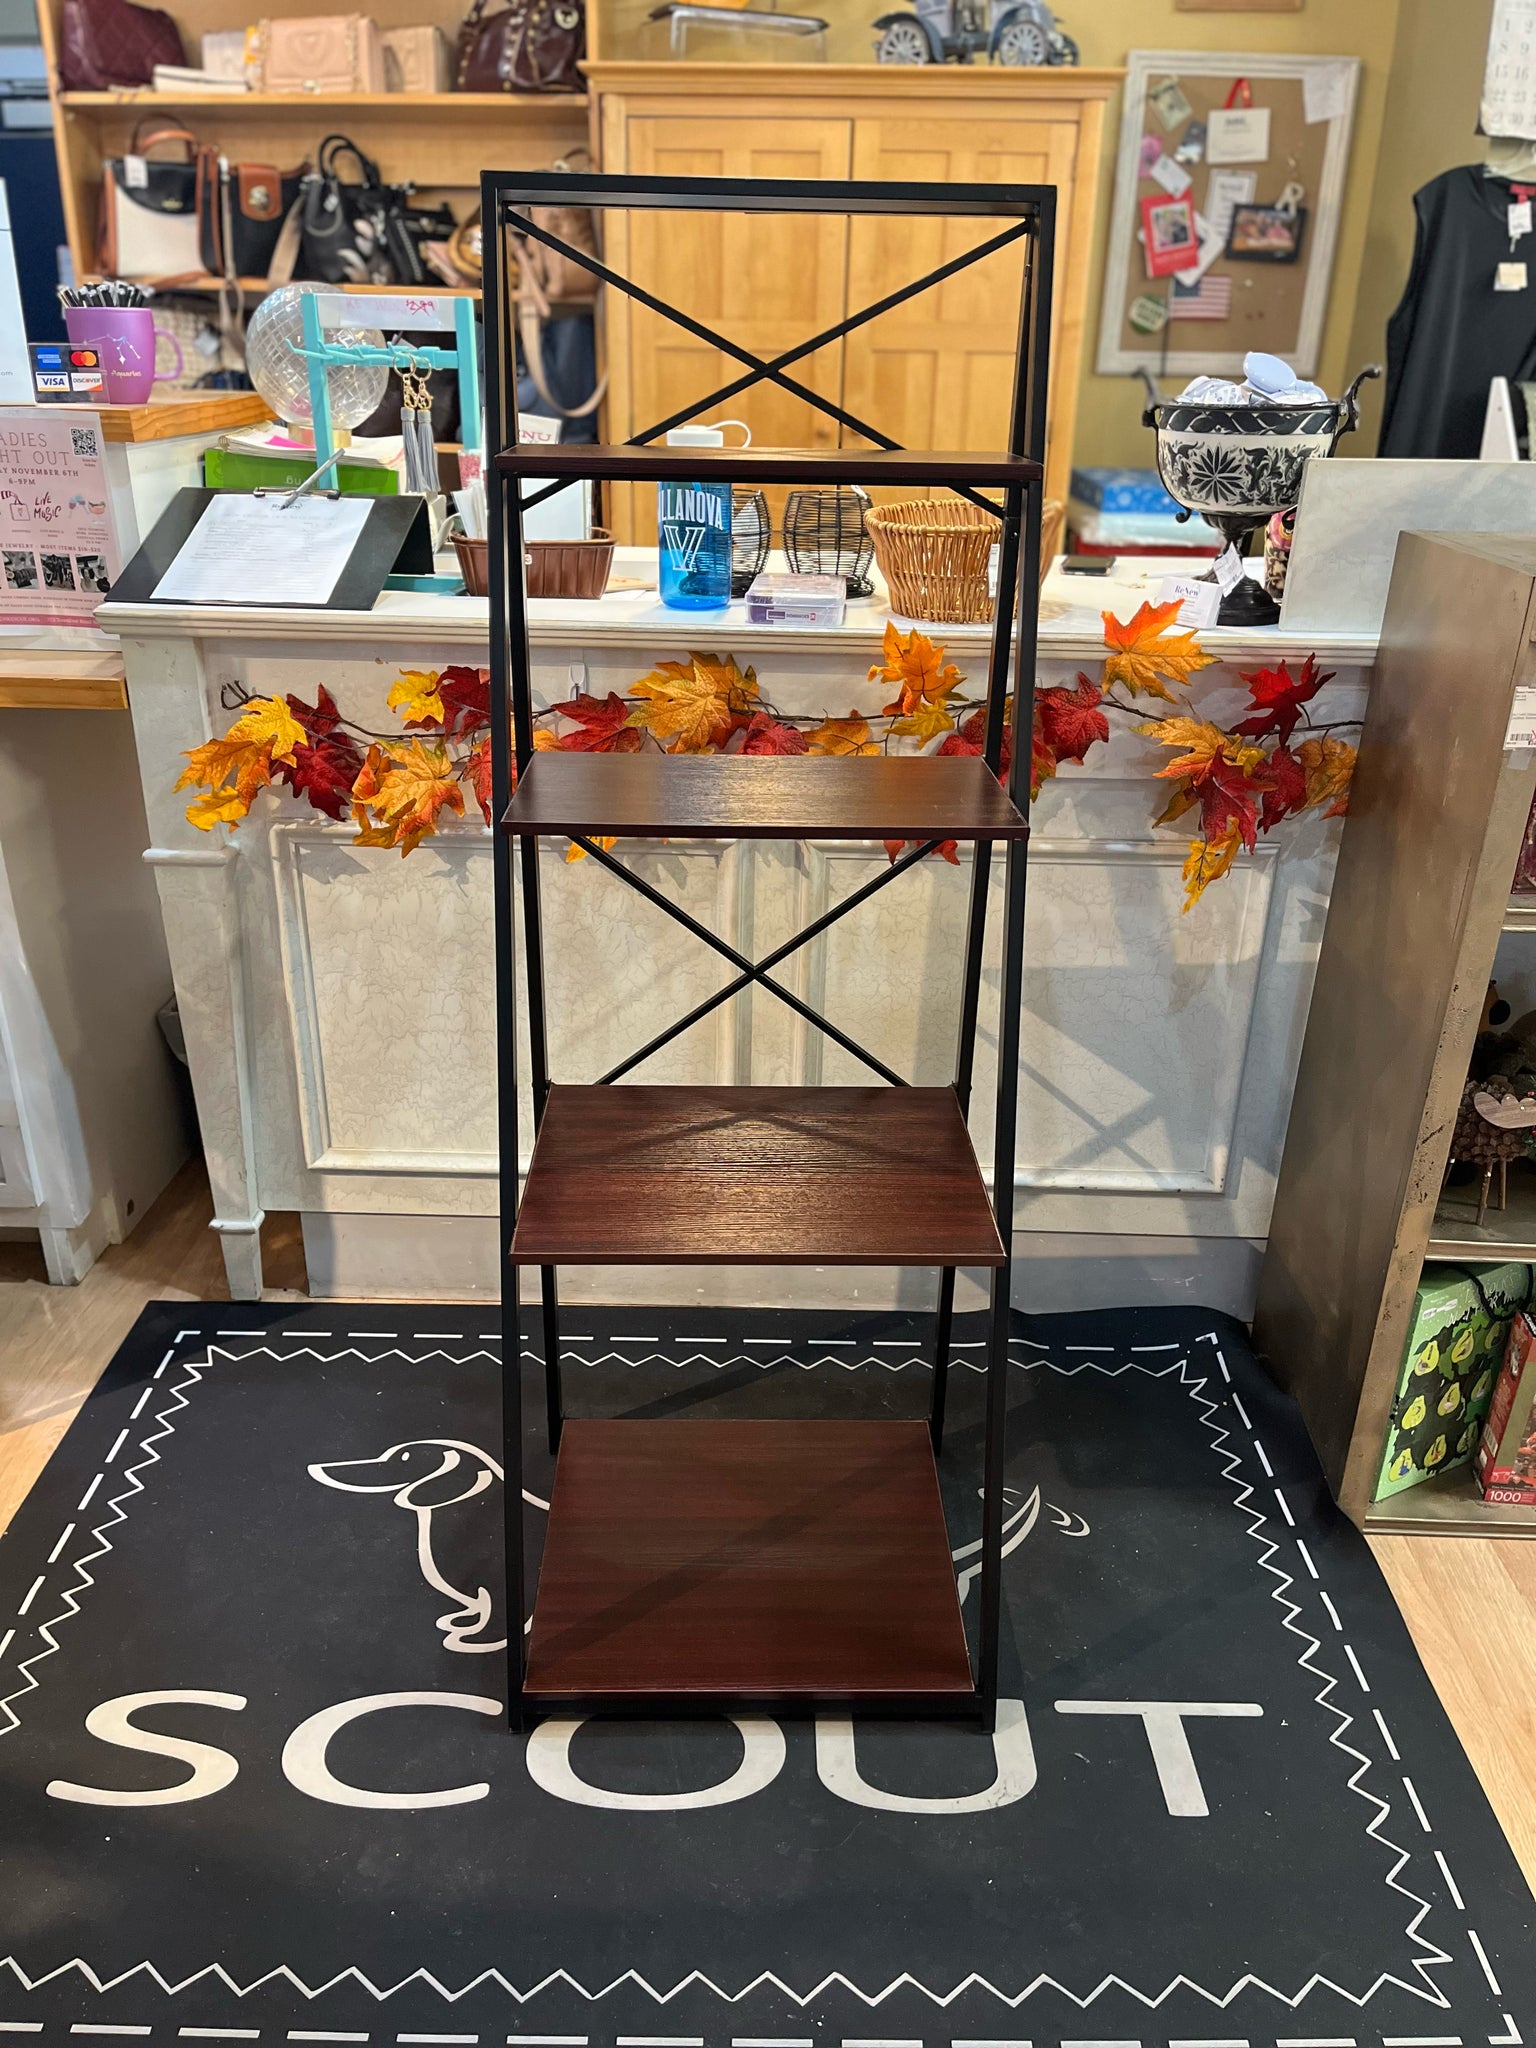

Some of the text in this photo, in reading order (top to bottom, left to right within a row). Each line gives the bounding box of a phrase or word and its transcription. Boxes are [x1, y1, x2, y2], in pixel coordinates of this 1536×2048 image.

[42, 377, 65, 386] VISA
[33, 450, 70, 466] OUT
[11, 467, 59, 476] NOVEMBER
[62, 469, 79, 477] 6TH
[664, 524, 706, 572] V
[1489, 1490, 1521, 1503] 1000
[46, 1688, 1265, 1818] SCOUT
